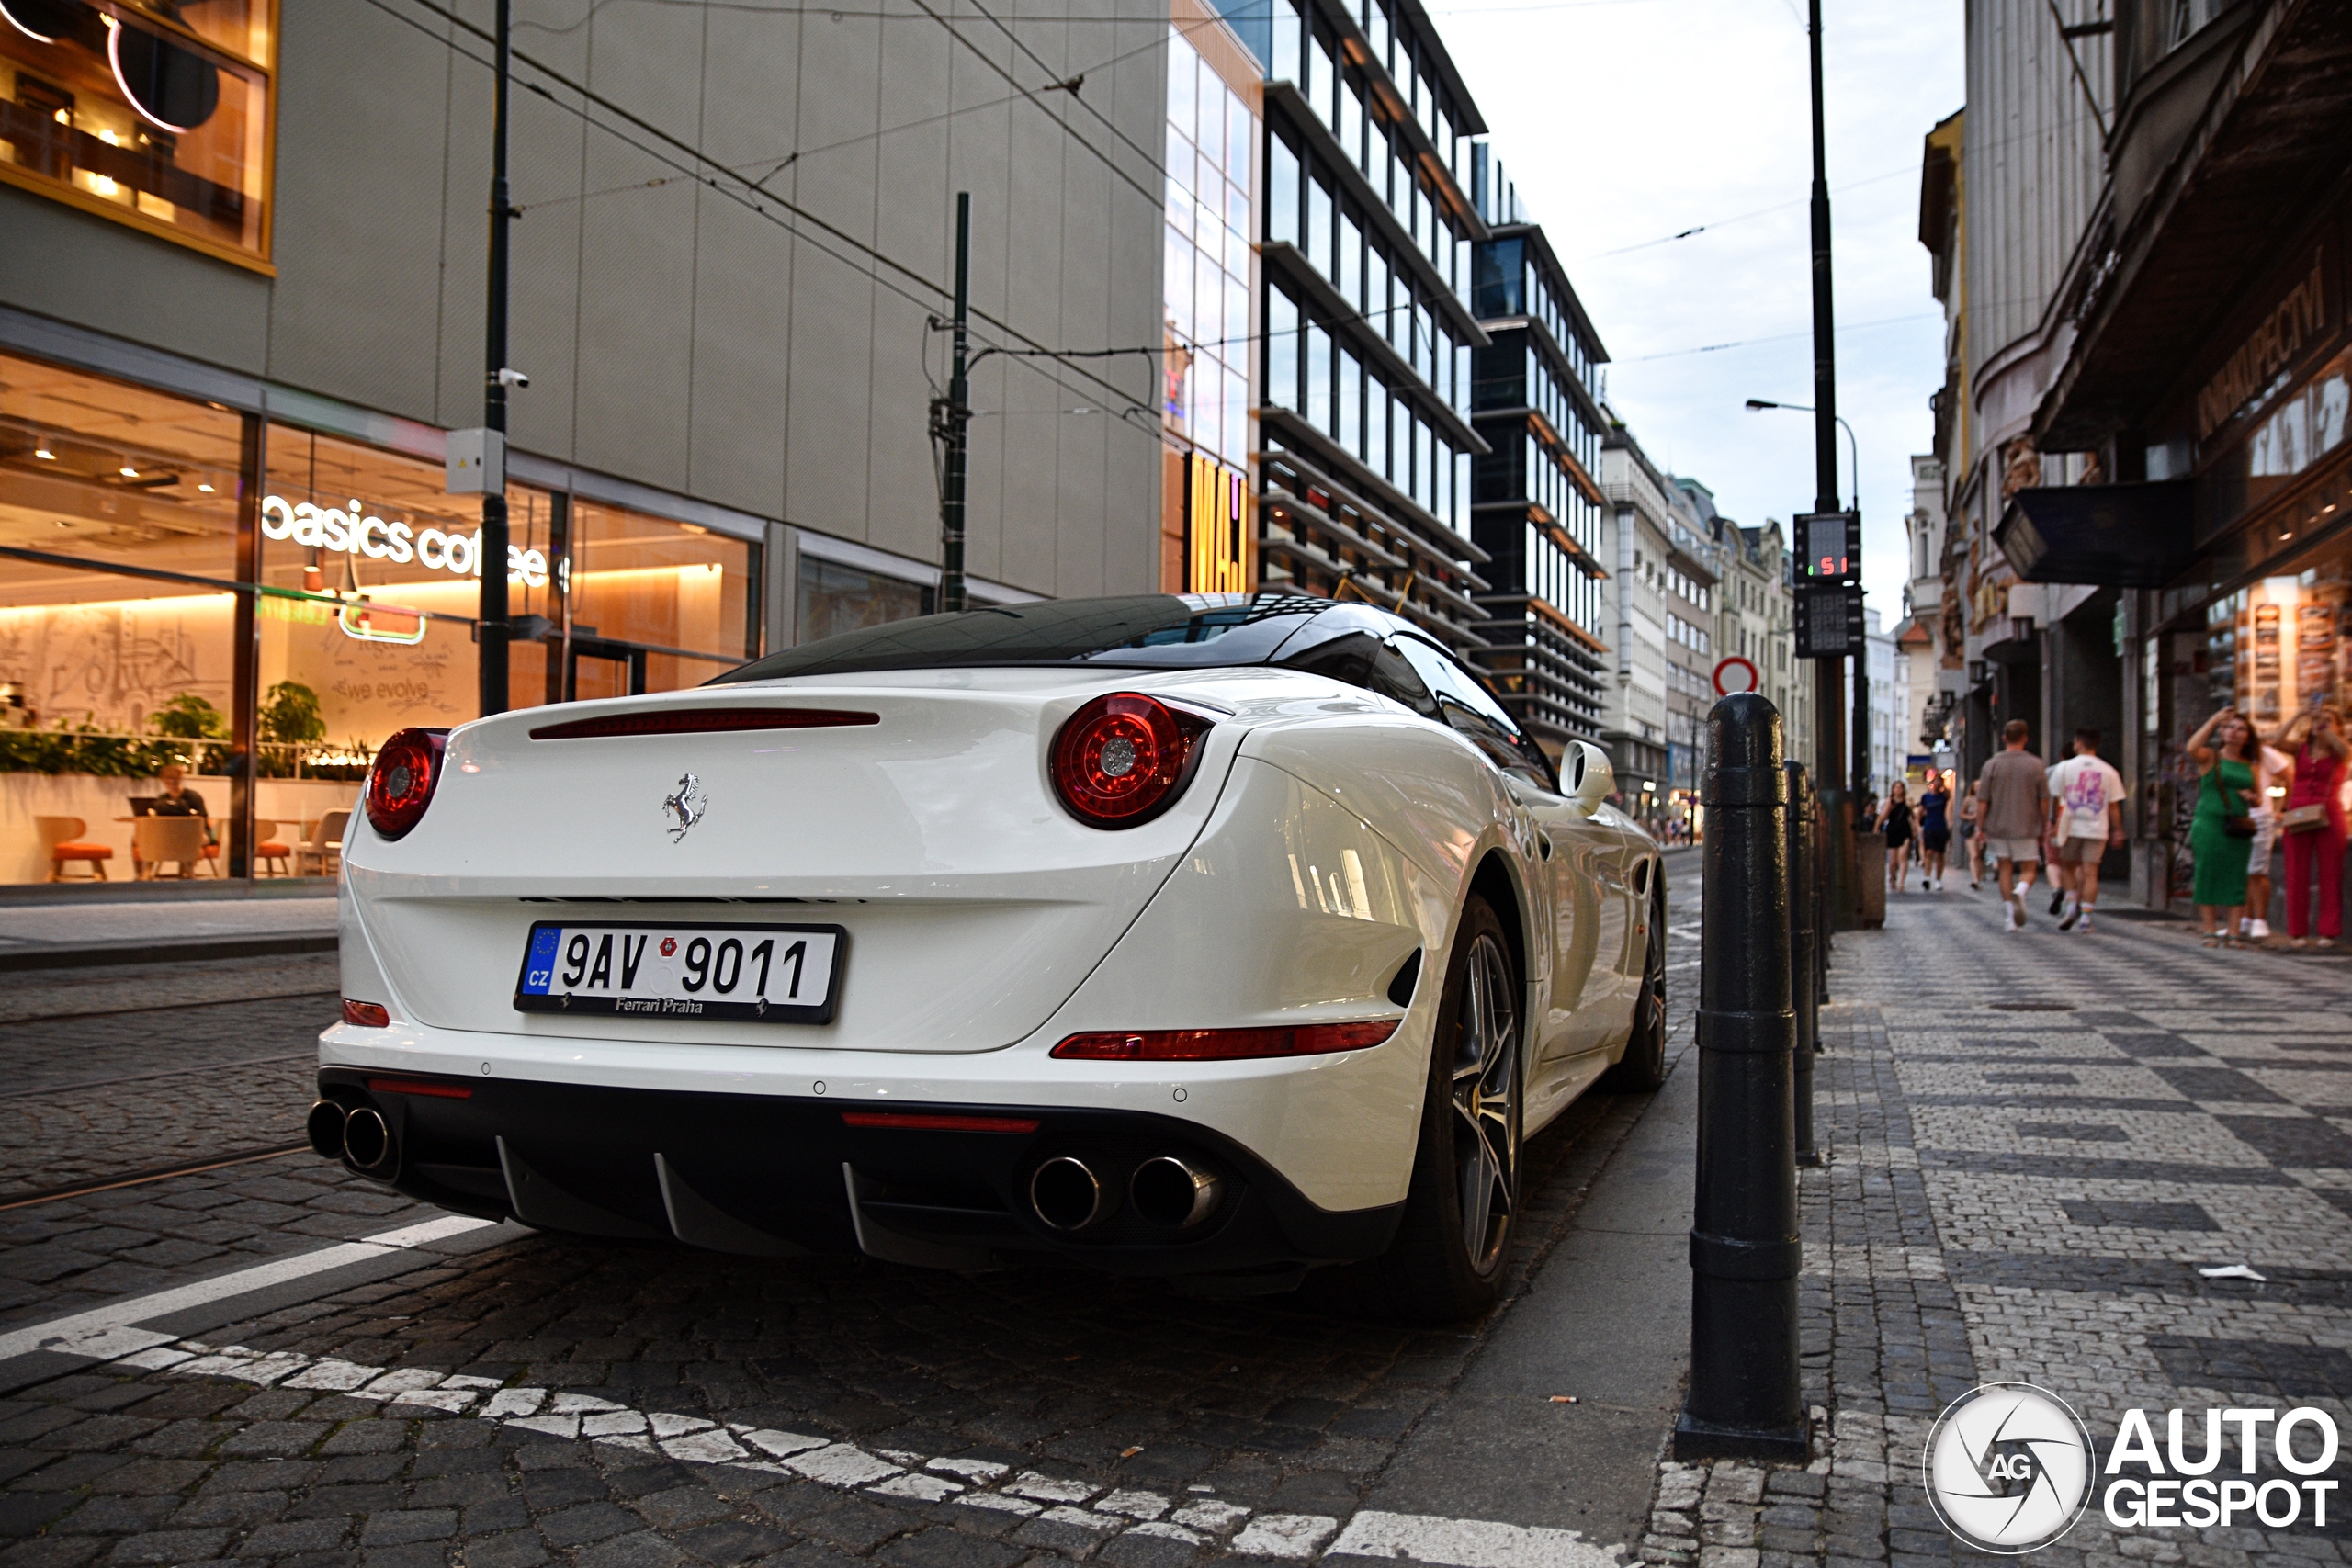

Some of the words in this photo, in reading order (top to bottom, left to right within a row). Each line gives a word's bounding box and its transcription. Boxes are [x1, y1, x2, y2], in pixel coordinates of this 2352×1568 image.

[417, 526, 548, 588] cofee
[376, 677, 429, 700] evolve
[562, 933, 648, 990] 9AV
[682, 937, 808, 998] 9011
[528, 970, 550, 987] CZ
[615, 996, 661, 1012] Ferrari
[662, 998, 703, 1014] Praha
